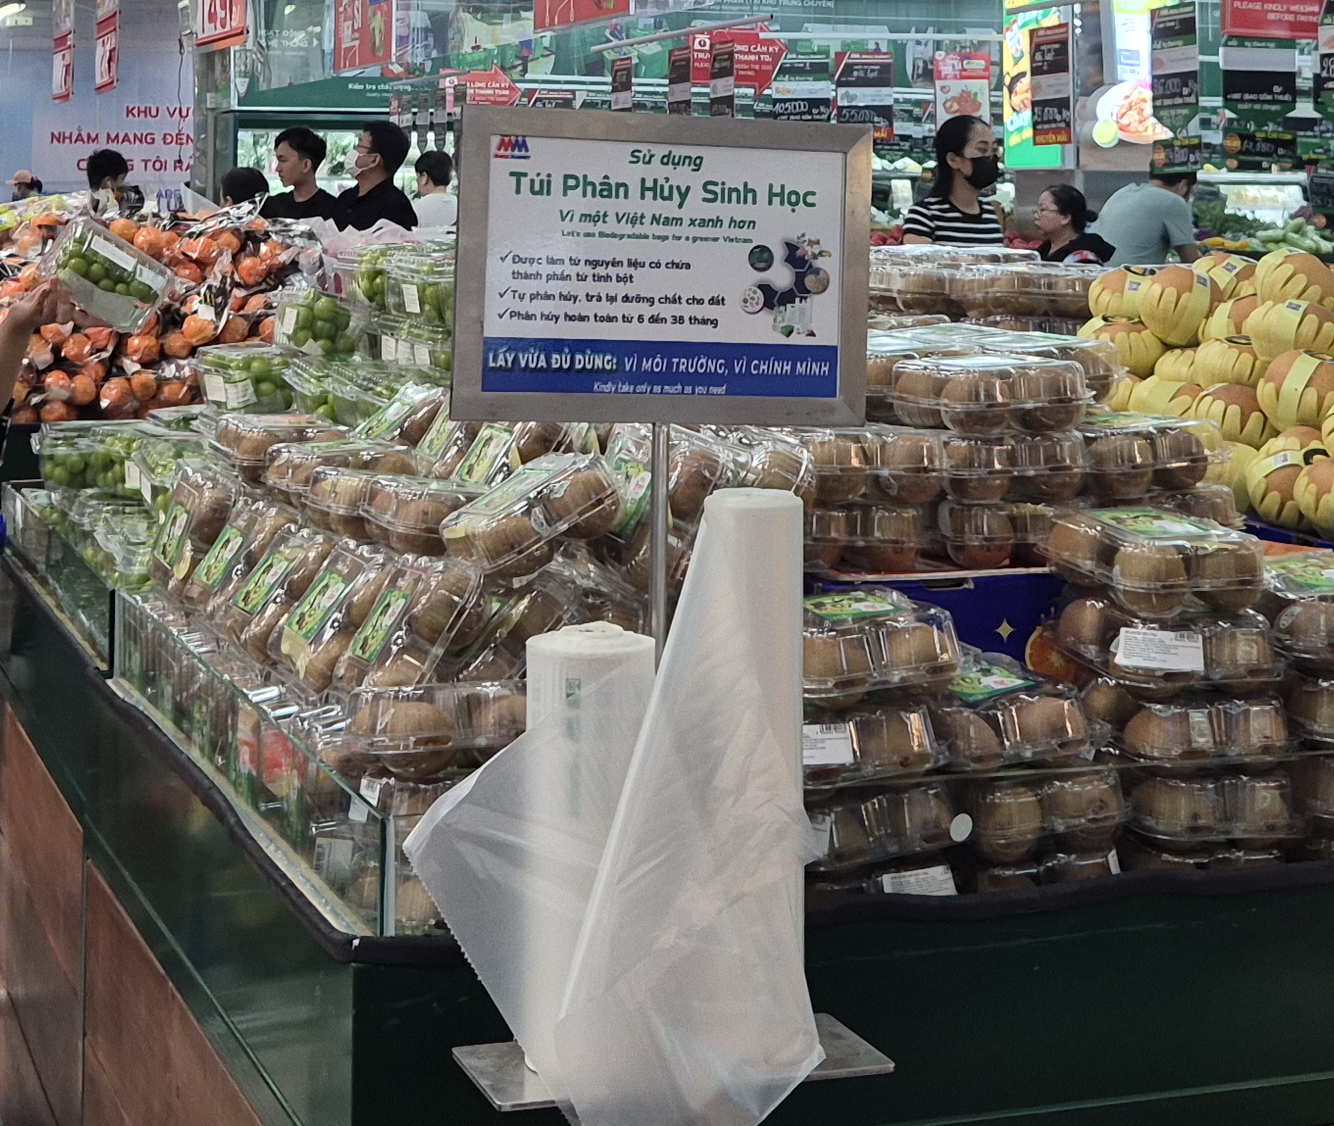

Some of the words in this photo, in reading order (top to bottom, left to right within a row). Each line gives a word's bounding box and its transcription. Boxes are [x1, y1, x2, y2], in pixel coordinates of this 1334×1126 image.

[125, 105, 160, 120] KHU
[105, 131, 156, 146] MANG
[628, 148, 656, 165] Sử
[660, 150, 705, 172] dụng
[508, 170, 553, 198] Túi
[562, 173, 630, 200] Phân
[640, 175, 692, 210] Hủy
[701, 180, 758, 206] Sinh
[768, 183, 818, 214] Học
[578, 211, 610, 227] một
[614, 210, 647, 228] Việt
[650, 213, 684, 228] Nam
[688, 215, 725, 230] xanh
[728, 217, 757, 231] hơn
[721, 235, 754, 244] Vietnam
[511, 253, 543, 268] Được
[545, 254, 566, 267] làm
[583, 256, 624, 271] nguyên
[626, 257, 646, 272] liệu
[648, 258, 663, 270] có
[664, 258, 692, 271] chứa
[615, 272, 635, 285] bột
[510, 289, 527, 304] Tự
[529, 290, 557, 304] phân
[605, 291, 619, 305] lại
[657, 293, 684, 306] chất
[685, 294, 706, 306] cho
[707, 294, 727, 308] đất
[508, 310, 538, 323] Phân
[563, 311, 591, 323] hoàn
[593, 312, 619, 324] toàn
[637, 314, 645, 324] 6
[647, 312, 668, 325] đến
[688, 314, 720, 329] tháng
[488, 344, 517, 370] LẤY
[518, 348, 548, 370] VỪA
[550, 347, 573, 371] ĐỦ
[574, 349, 618, 371] DÙNG:
[623, 353, 639, 372] VÌ
[640, 352, 669, 373] MÔI
[671, 354, 730, 377] TRƯỜNG,
[733, 356, 750, 375] VÌ
[750, 356, 793, 376] CHÍNH
[794, 357, 831, 377] MÌNH
[592, 381, 617, 394] Kindly
[617, 381, 636, 394] take
